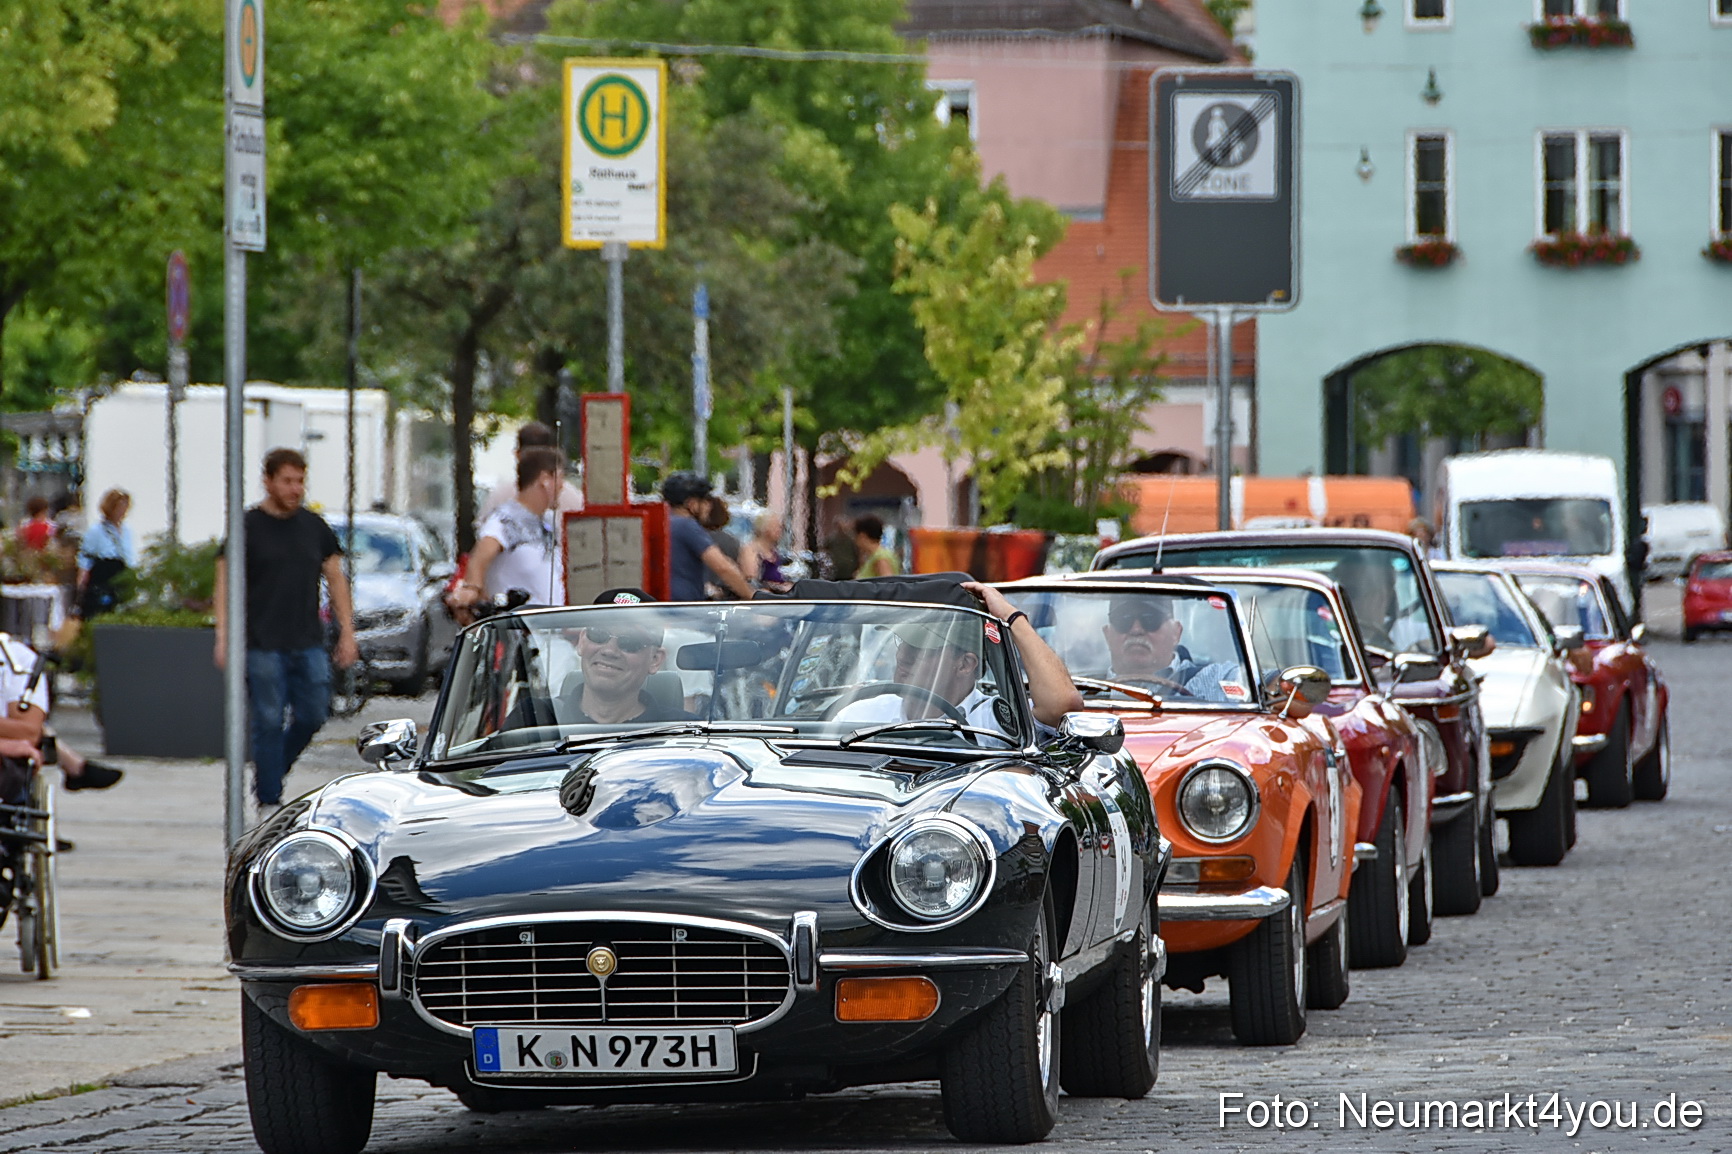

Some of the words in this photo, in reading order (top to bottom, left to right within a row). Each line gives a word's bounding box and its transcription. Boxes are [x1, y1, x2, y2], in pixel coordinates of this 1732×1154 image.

[600, 94, 627, 138] H
[1200, 173, 1251, 191] ZONE
[483, 1053, 493, 1064] D
[516, 1034, 544, 1067] K
